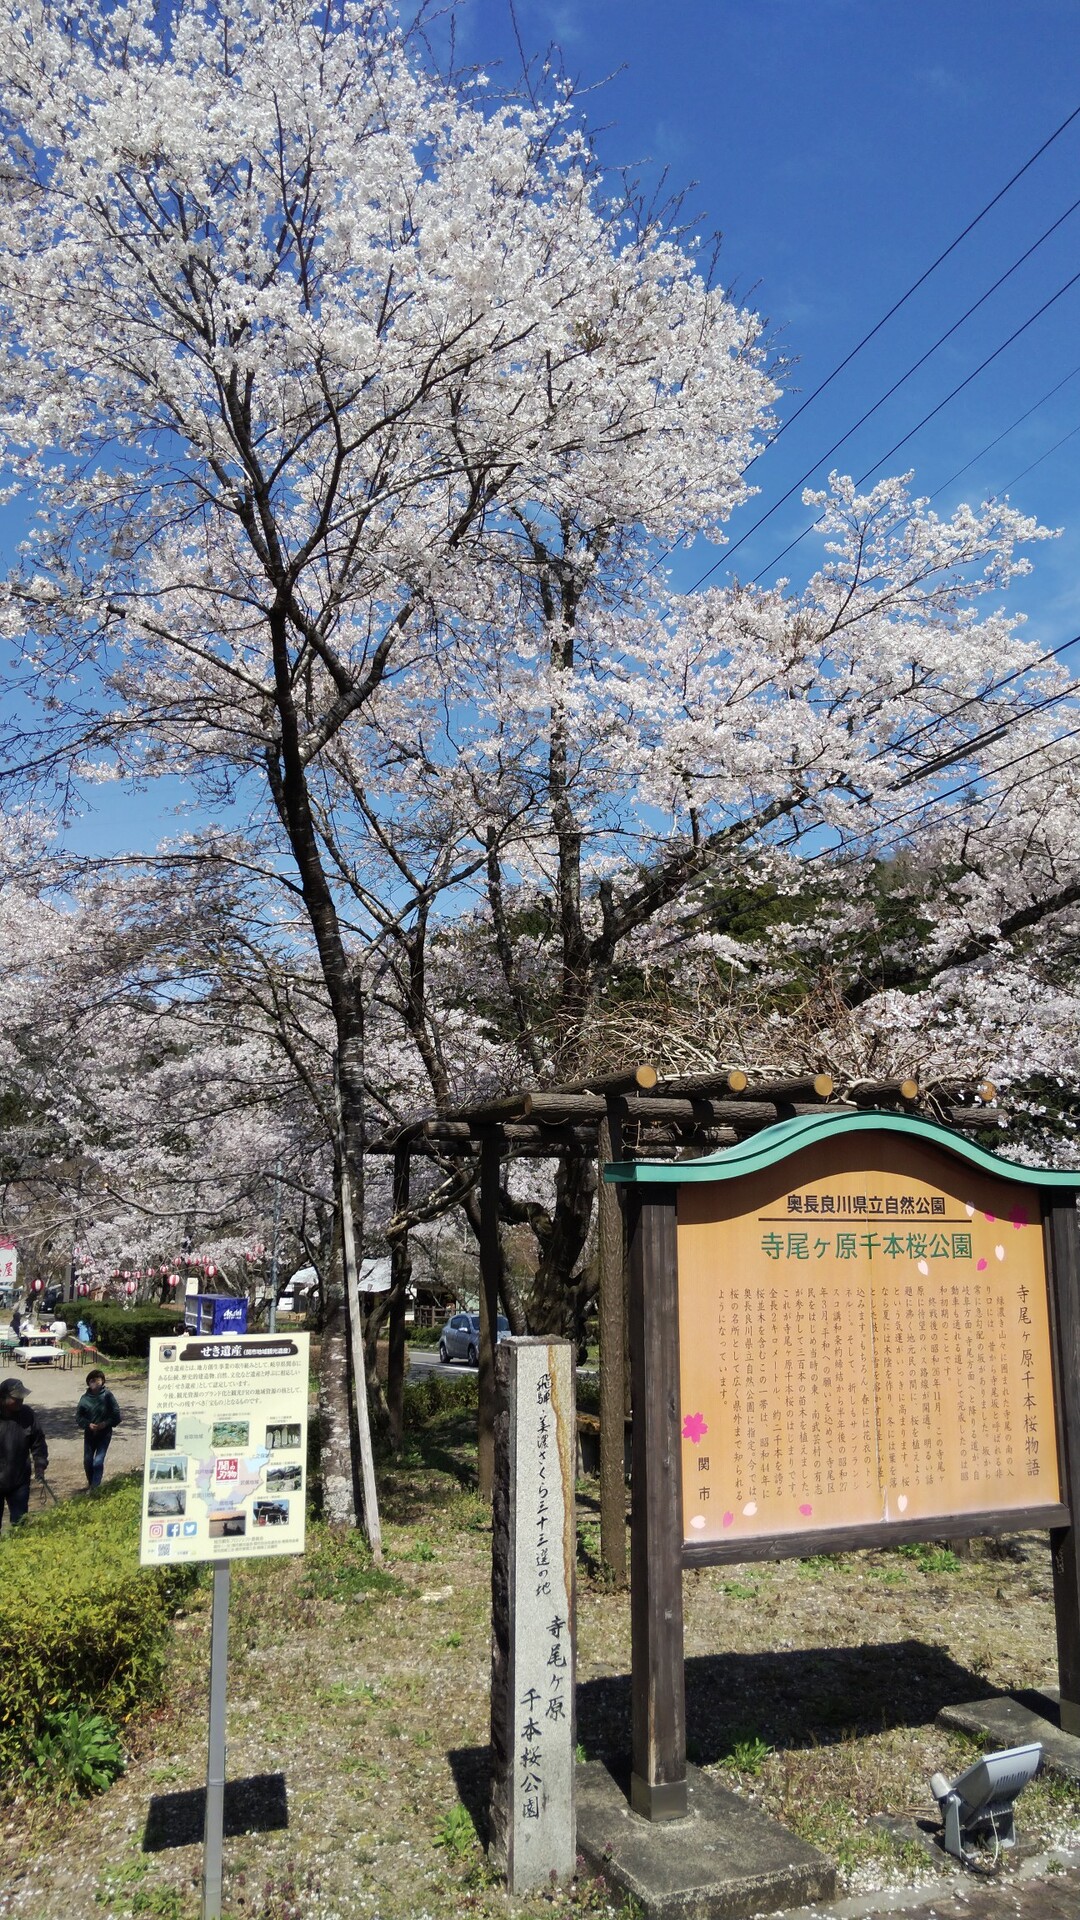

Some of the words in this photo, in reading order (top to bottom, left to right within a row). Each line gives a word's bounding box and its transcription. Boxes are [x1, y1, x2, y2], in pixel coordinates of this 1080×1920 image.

[787, 1194, 946, 1215] 奥長良川県立自然公園
[761, 1231, 973, 1260] 寺尾ヶ原千本桜公園
[200, 1345, 242, 1357] せき遺産
[1016, 1284, 1041, 1476] 寺尾ヶ原千本桜物語
[520, 1688, 543, 1820] 千本桜公園
